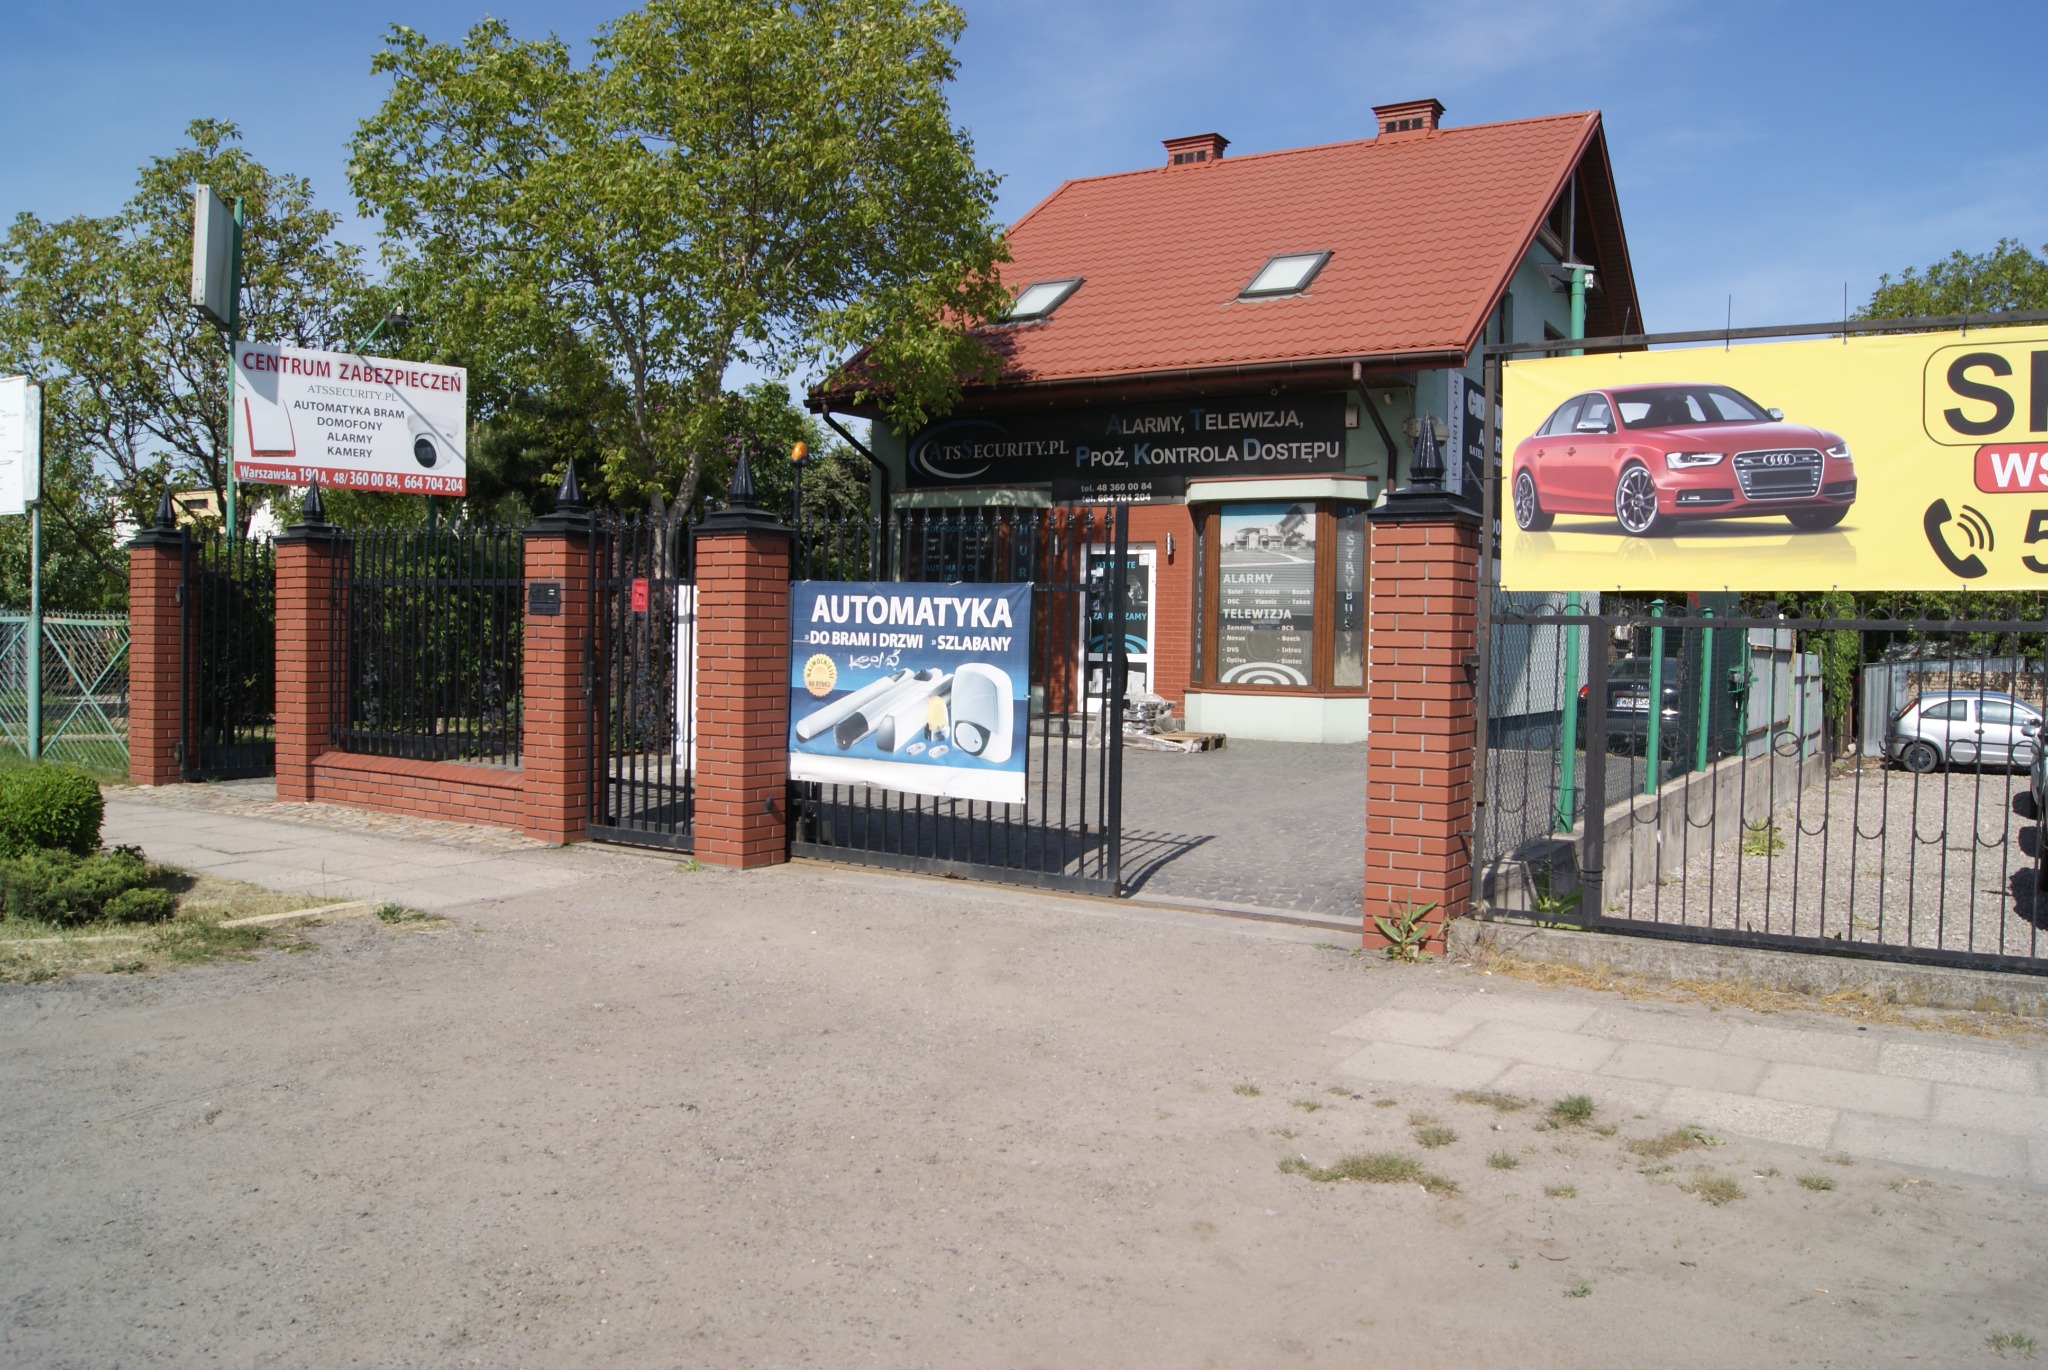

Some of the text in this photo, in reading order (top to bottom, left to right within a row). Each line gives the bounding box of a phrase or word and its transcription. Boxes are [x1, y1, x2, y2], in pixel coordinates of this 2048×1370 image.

[243, 352, 461, 392] CENTRUM ZABEZPIECZEŃ
[307, 384, 398, 402] ATSSECURITY.PL
[1944, 350, 2048, 436] S
[294, 400, 405, 419] AUTOMATYKA BRAM
[317, 416, 382, 431] DOMOFONY
[1105, 408, 1304, 436] ALARMY, TELEWIZJA,
[327, 432, 372, 444] ALARMY
[327, 446, 372, 458] KAMERY
[1075, 438, 1340, 469] PPOŻ, KONTROLA DOSTĘPU
[240, 465, 463, 492] Warszawska 190 A, 48/ 360 00 84, 664 704 204
[1081, 482, 1152, 492] tel. 48 360 00 84
[1098, 494, 1114, 503] 664
[1116, 494, 1132, 502] 704
[1134, 493, 1151, 502] 204
[1223, 574, 1274, 584] ALARMY
[811, 594, 1012, 628] AUTOMATYKA
[1093, 612, 1147, 620] ZARZAMY
[1223, 609, 1292, 620] TELEWIZJA
[810, 630, 1012, 652] DO BRAM I DRZWI SZLABANY
